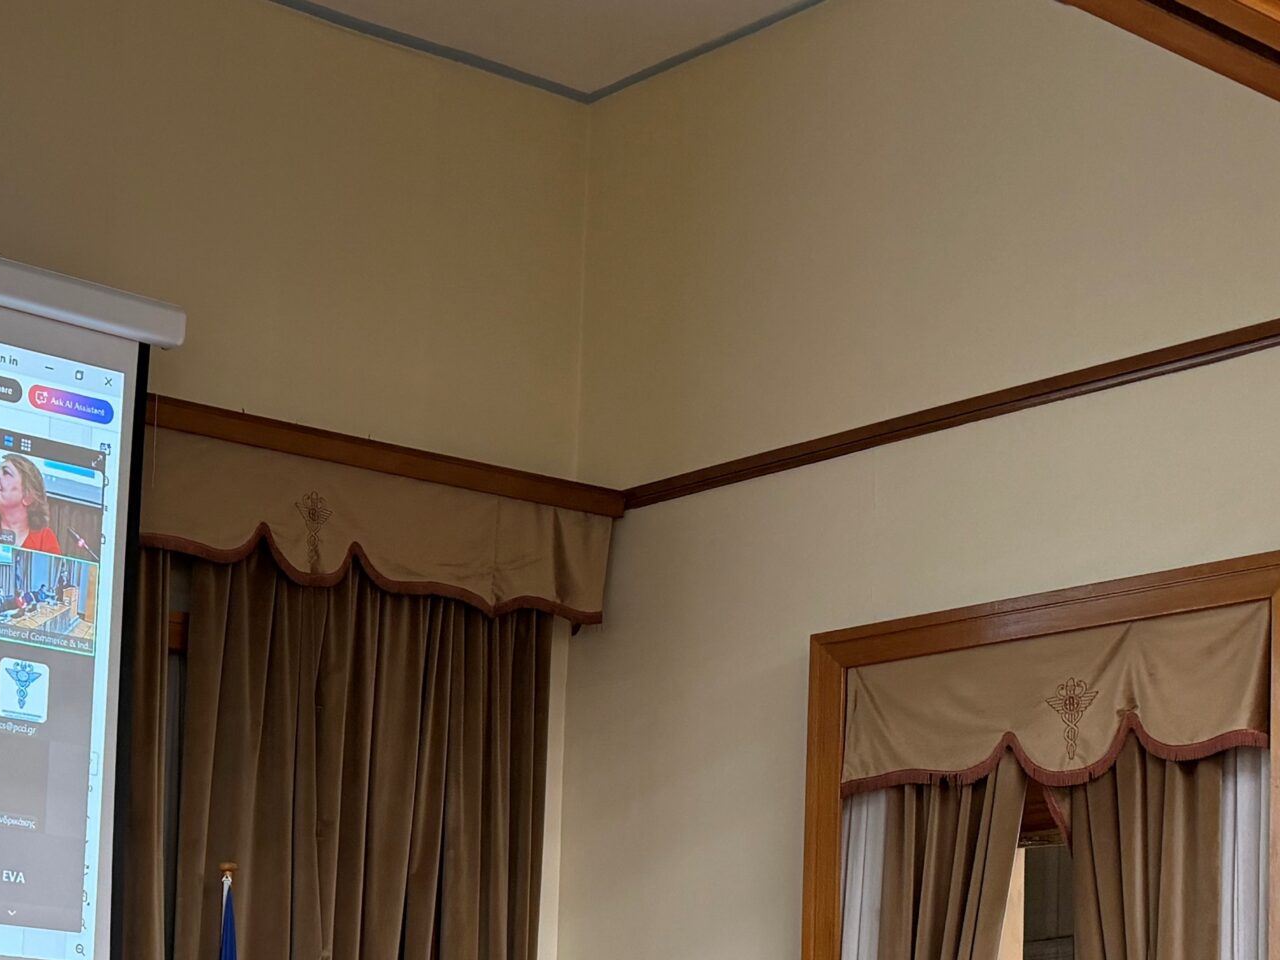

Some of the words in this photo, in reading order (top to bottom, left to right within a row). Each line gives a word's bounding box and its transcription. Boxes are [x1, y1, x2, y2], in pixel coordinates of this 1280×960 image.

[9, 356, 18, 367] in
[50, 397, 64, 406] Ask
[75, 402, 105, 416] Assistant
[21, 630, 29, 640] of
[30, 632, 68, 647] Commerce
[69, 638, 76, 647] &
[2, 870, 25, 884] EVA
